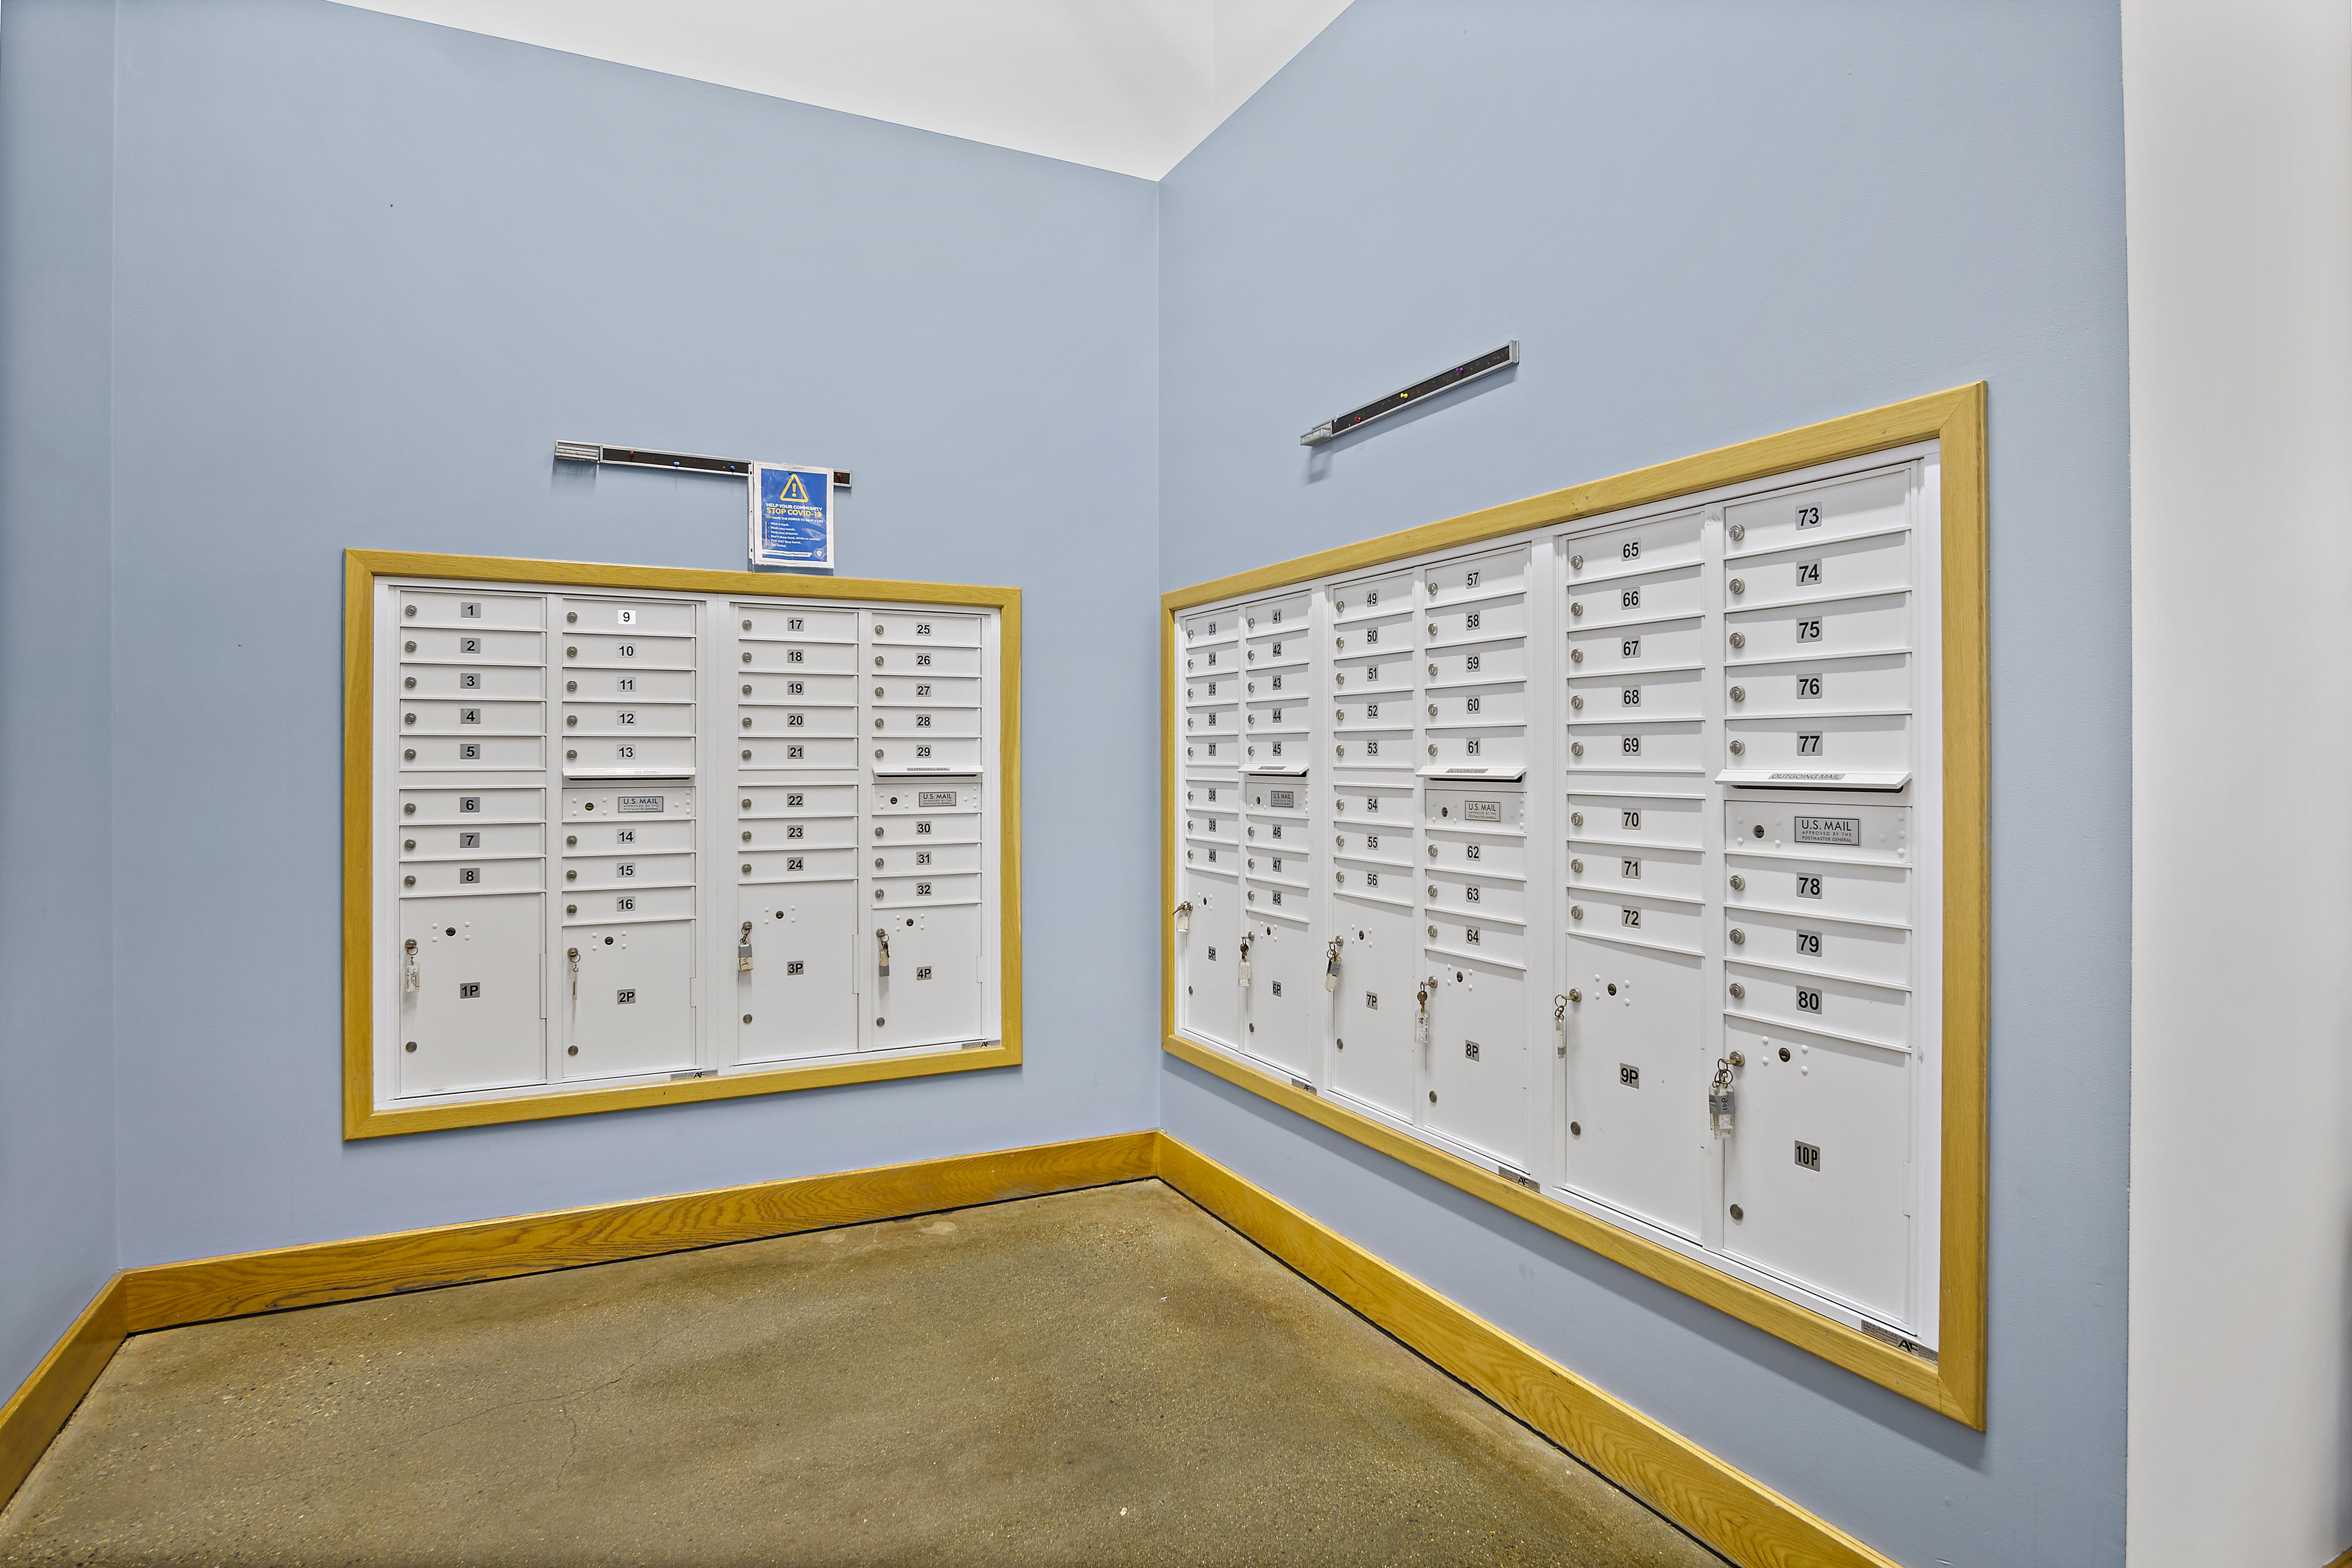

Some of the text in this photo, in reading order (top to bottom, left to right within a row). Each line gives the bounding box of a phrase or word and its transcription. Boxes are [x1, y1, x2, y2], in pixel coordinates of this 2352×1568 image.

[788, 509, 822, 517] COVID-19
[1798, 507, 1819, 526] 73
[1623, 542, 1639, 558] 65
[1467, 572, 1479, 586] 57
[1799, 564, 1819, 583] 74
[1367, 593, 1377, 605] 49
[1623, 591, 1639, 607] 66
[467, 605, 473, 616] 1
[623, 612, 630, 622] 9
[1273, 611, 1280, 622] 41
[1467, 614, 1479, 628] 58
[789, 619, 802, 629] 17
[917, 625, 930, 634] 25
[1209, 624, 1216, 634] 33
[1799, 621, 1820, 639] 75
[1367, 630, 1377, 642] 50
[467, 640, 475, 651] 2
[619, 646, 634, 656] 10
[1273, 644, 1281, 655] 42
[1623, 640, 1639, 656] 67
[789, 652, 802, 662] 18
[917, 655, 930, 665] 26
[1209, 654, 1216, 664] 34
[1467, 656, 1479, 670] 59
[1369, 667, 1377, 679] 51
[467, 675, 474, 686] 3
[620, 679, 632, 690] 11
[1273, 677, 1281, 688] 43
[789, 683, 802, 693] 19
[917, 686, 930, 695] 27
[1209, 684, 1216, 694] 35
[1799, 678, 1820, 695] 76
[1624, 690, 1639, 704] 68
[1468, 698, 1479, 712] 60
[466, 711, 475, 722] 4
[1273, 710, 1281, 721] 44
[1368, 705, 1377, 717] 52
[619, 713, 634, 724] 12
[789, 715, 803, 725] 20
[917, 717, 930, 726] 28
[1209, 715, 1216, 724] 36
[1273, 744, 1281, 754] 45
[1368, 742, 1377, 754] 53
[1468, 741, 1478, 753] 61
[1623, 738, 1639, 752] 69
[1799, 735, 1820, 752] 77
[467, 746, 474, 757] 5
[619, 747, 633, 757] 13
[790, 747, 802, 757] 21
[918, 747, 930, 757] 29
[1209, 745, 1216, 754] 37
[1209, 790, 1215, 800] 38
[466, 799, 474, 810] 6
[788, 796, 802, 806] 22
[1368, 798, 1378, 810] 54
[1209, 820, 1215, 830] 39
[1624, 812, 1639, 827] 70
[918, 823, 930, 833] 30
[1802, 820, 1852, 831] U.S. MAIL
[619, 831, 634, 842] 14
[789, 827, 802, 837] 23
[1273, 827, 1281, 837] 46
[466, 835, 474, 846] 7
[1368, 836, 1378, 848] 55
[1209, 851, 1216, 861] 40
[1467, 846, 1479, 859] 62
[789, 859, 803, 869] 24
[918, 854, 929, 864] 31
[619, 865, 633, 876] 15
[1273, 860, 1281, 870] 47
[1624, 860, 1638, 876] 71
[466, 871, 474, 882] 8
[1367, 873, 1377, 885] 56
[918, 885, 931, 894] 32
[1799, 877, 1820, 895] 78
[1273, 893, 1281, 904] 48
[1467, 887, 1479, 901] 63
[619, 899, 633, 910] 16
[1623, 909, 1639, 926] 72
[1467, 929, 1479, 943] 64
[1799, 934, 1819, 953] 79
[1208, 949, 1215, 958] 5P
[789, 963, 803, 974] 3P
[918, 969, 931, 978] 4P
[462, 985, 478, 997] 1P
[1273, 983, 1281, 994] 6P
[619, 992, 634, 1003] 2P
[1367, 994, 1377, 1007] 7P
[1798, 991, 1819, 1010] 80
[1466, 1043, 1478, 1058] 8P
[1621, 1068, 1638, 1084] 9P
[1796, 1145, 1818, 1166] 10P
